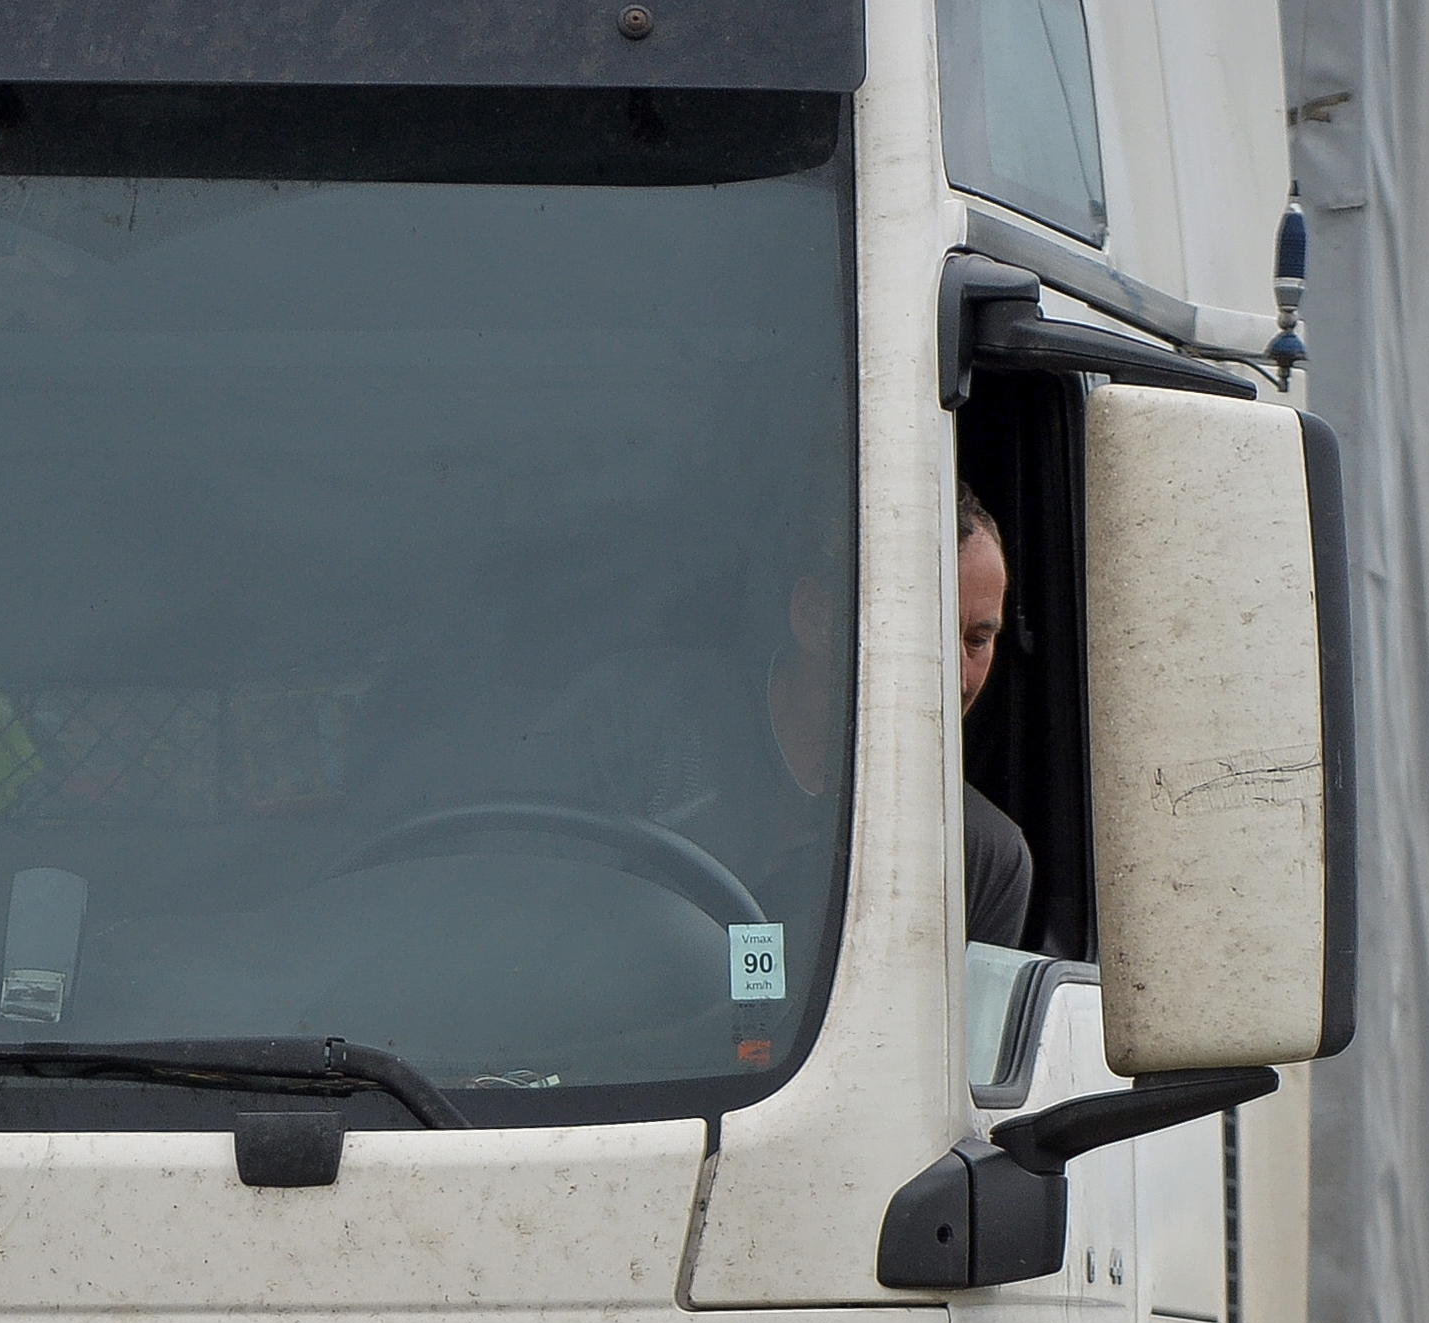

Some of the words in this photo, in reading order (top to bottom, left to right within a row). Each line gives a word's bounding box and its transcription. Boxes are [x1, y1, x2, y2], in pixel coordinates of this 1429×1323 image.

[741, 933, 774, 944] Vmax
[744, 953, 773, 974] 90
[744, 980, 773, 991] km/h
